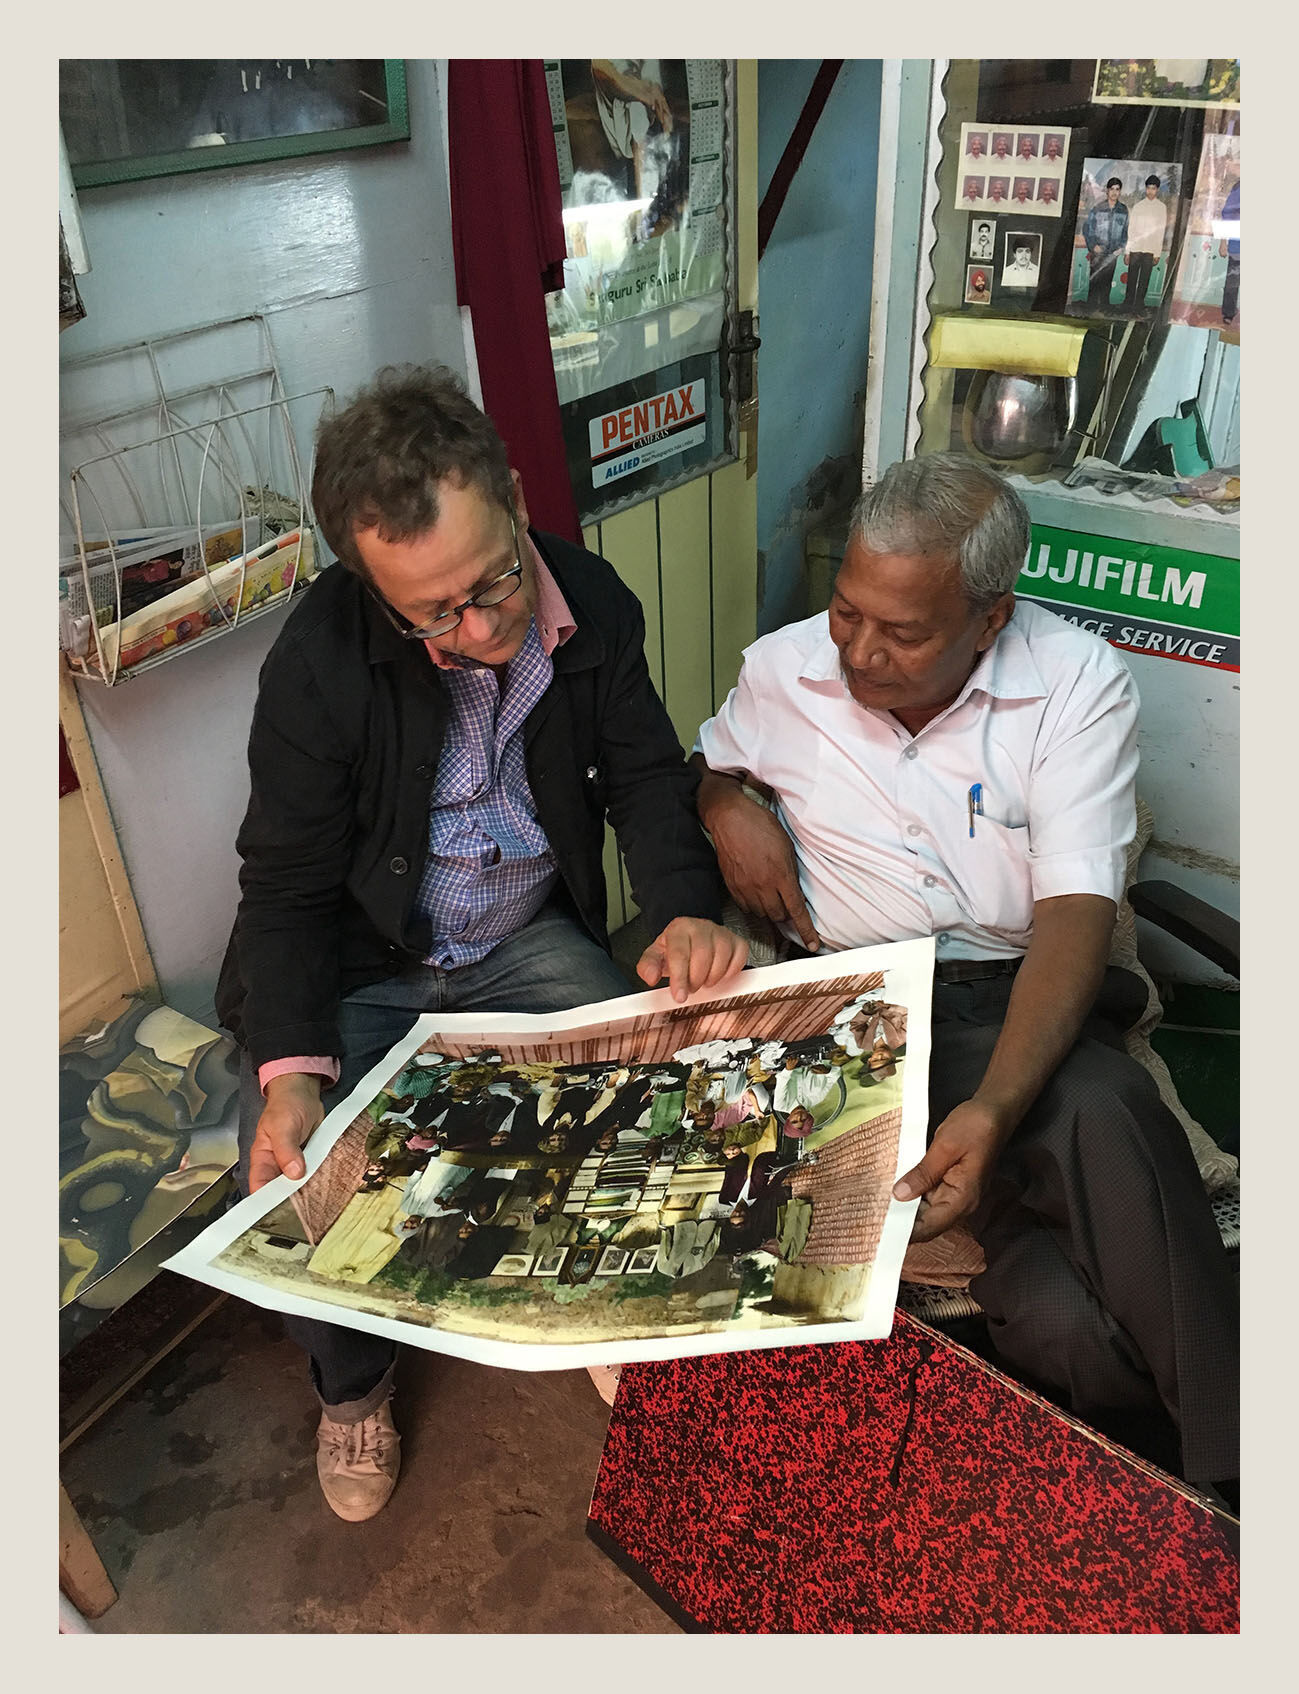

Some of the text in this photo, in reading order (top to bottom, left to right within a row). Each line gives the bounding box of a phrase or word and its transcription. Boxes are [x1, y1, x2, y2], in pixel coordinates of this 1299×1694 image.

[601, 385, 694, 449] PENTAX
[632, 429, 669, 450] CAMERAS
[605, 456, 640, 479] ALLIED
[1020, 542, 1207, 609] UJIFILM
[1116, 625, 1227, 664] SERVICE
